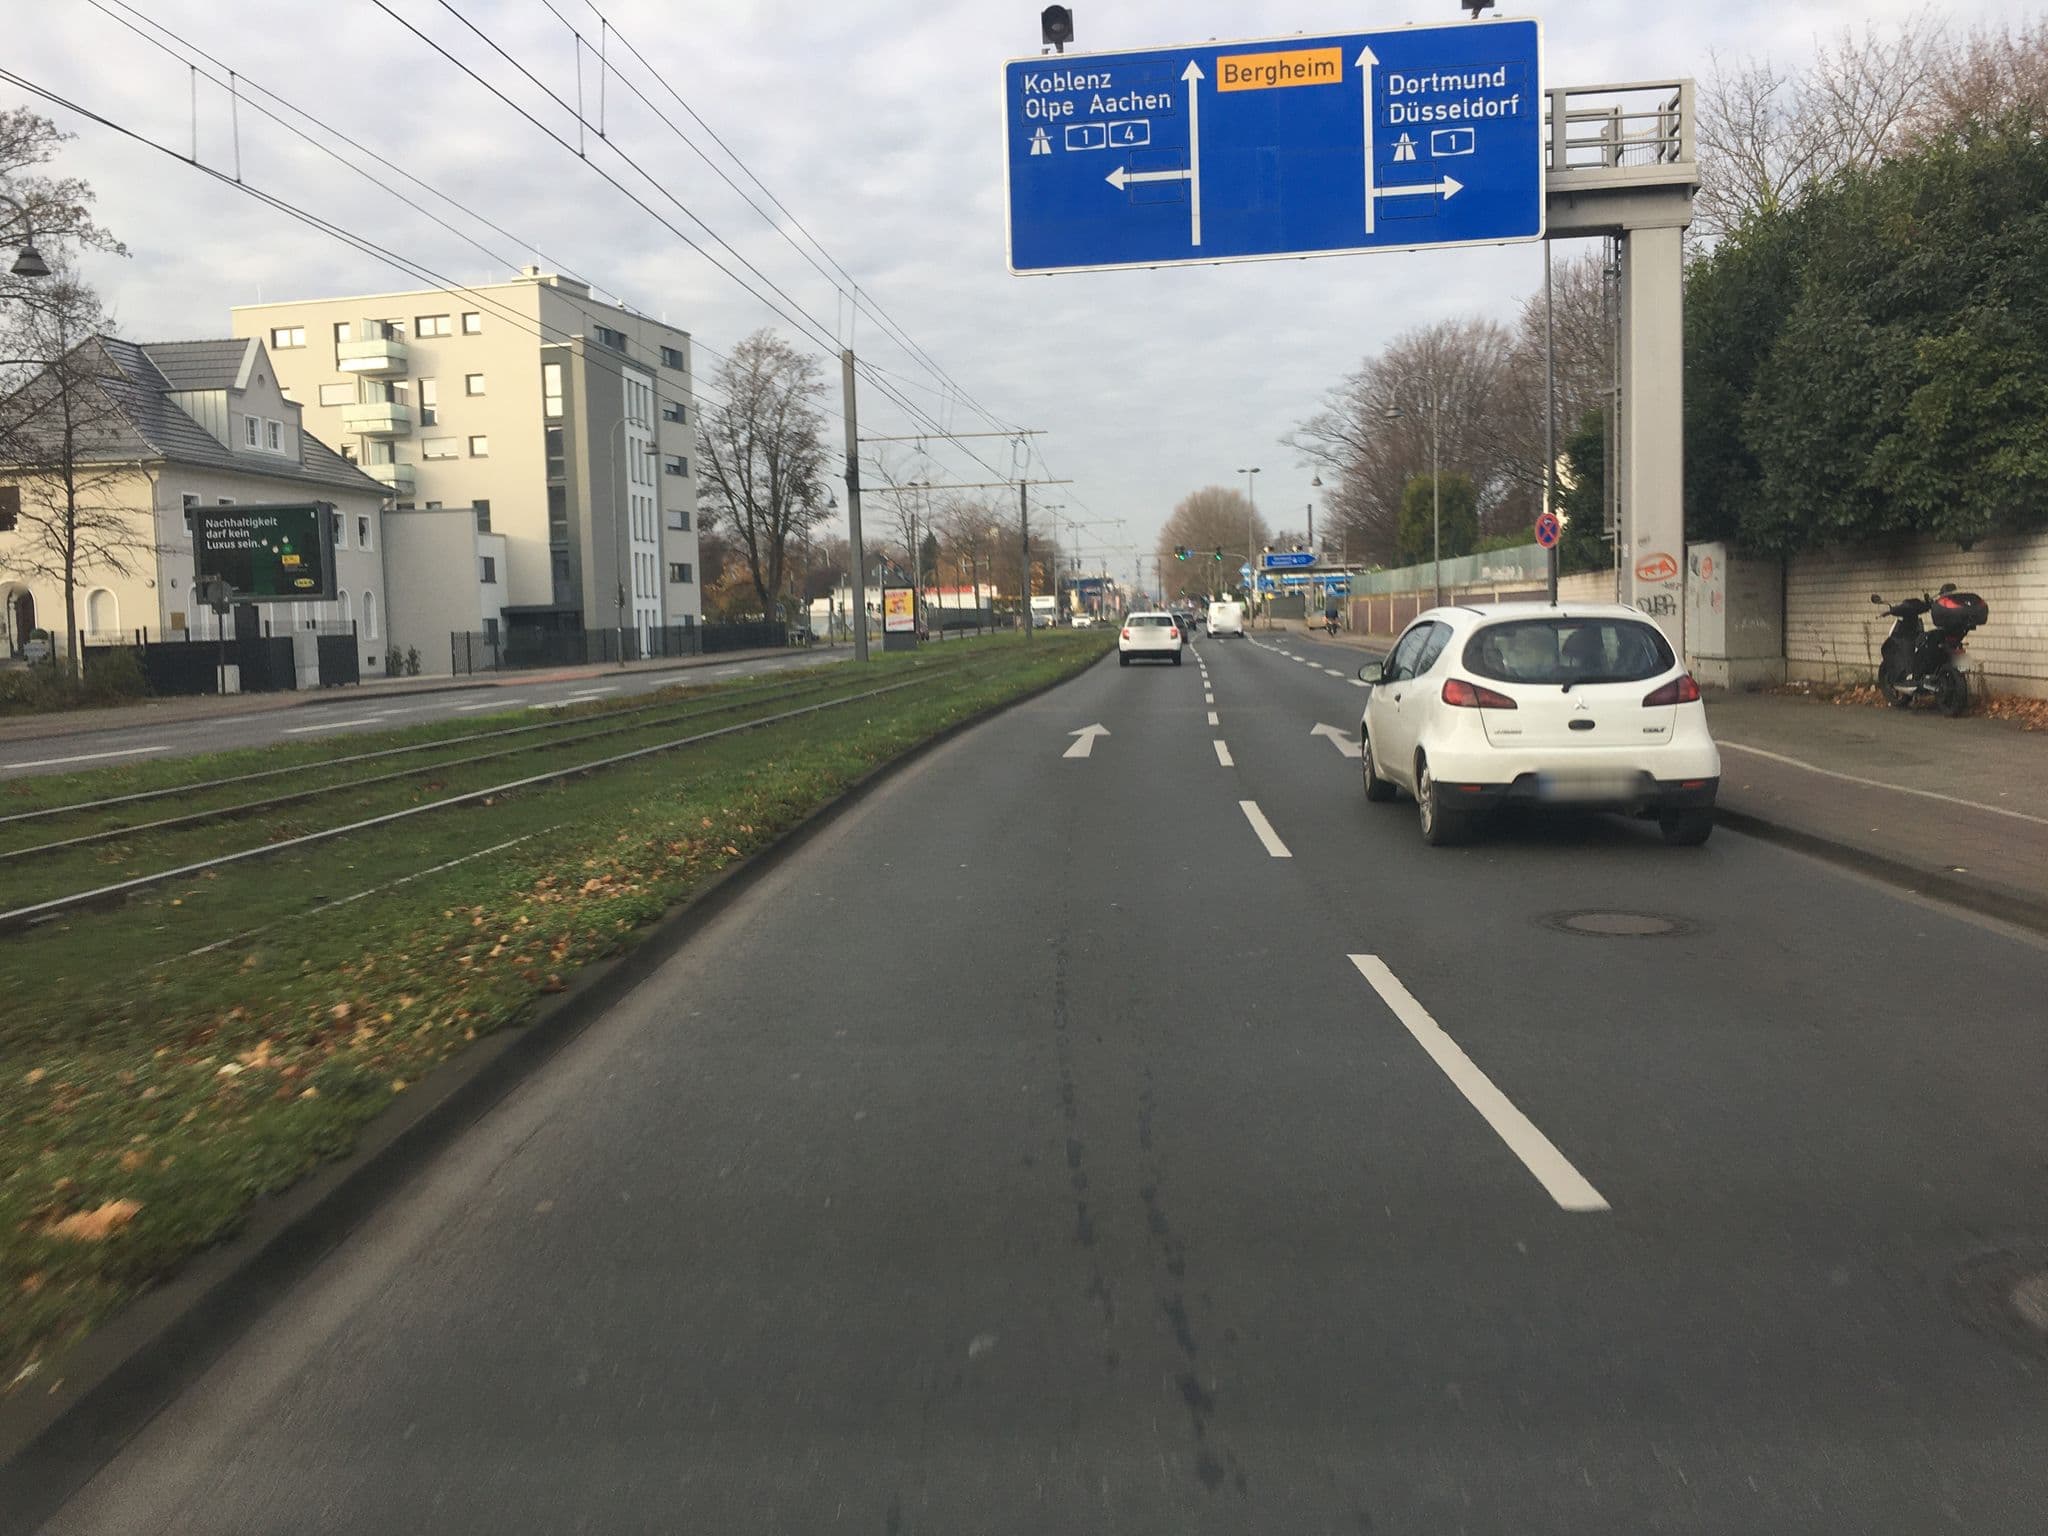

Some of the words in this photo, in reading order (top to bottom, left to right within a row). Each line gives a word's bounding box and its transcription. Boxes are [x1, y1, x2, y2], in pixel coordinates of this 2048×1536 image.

[1024, 71, 1112, 95] Koblenz
[1224, 58, 1334, 86] Bergheim
[1389, 66, 1506, 96] Dortmund
[1025, 98, 1074, 122] Olpe
[1089, 91, 1171, 114] Aachen
[1389, 93, 1519, 124] Düsseldorf
[1124, 125, 1135, 142] 4
[205, 517, 278, 529] Nachhaltigkeit
[206, 529, 226, 539] darf
[228, 529, 250, 538] kein
[207, 540, 236, 550] Luxus
[237, 539, 261, 549] sein.
